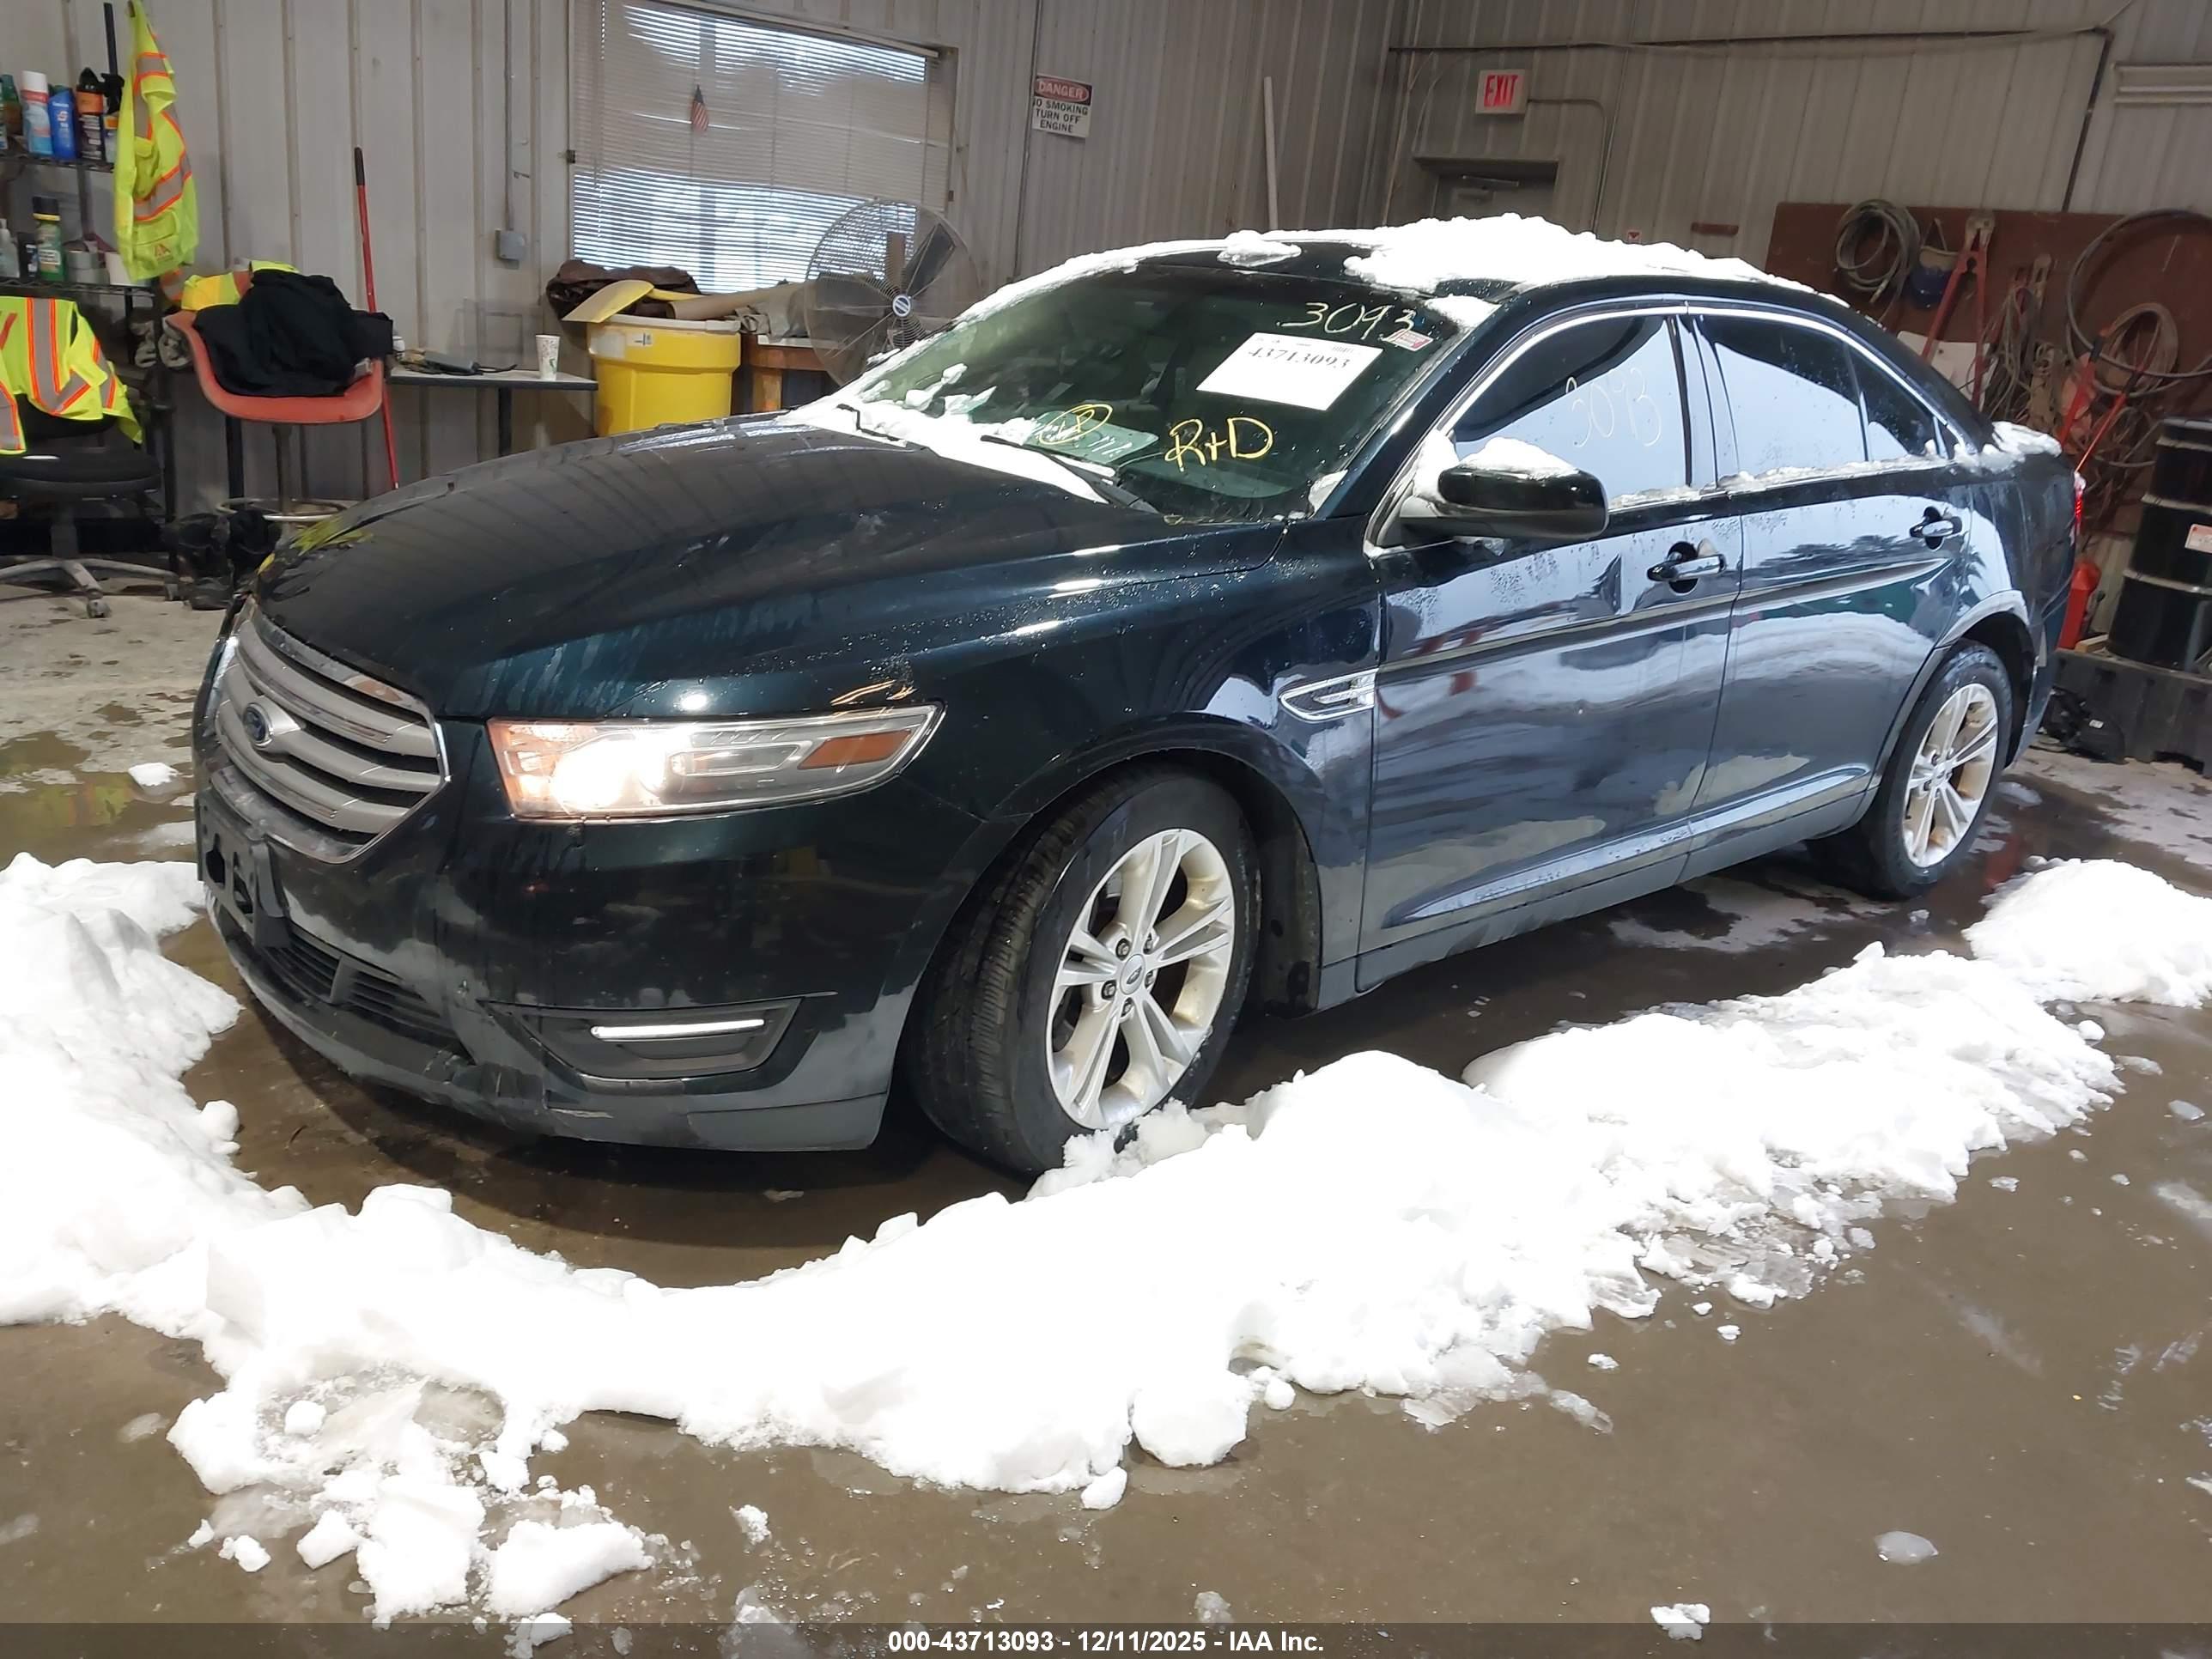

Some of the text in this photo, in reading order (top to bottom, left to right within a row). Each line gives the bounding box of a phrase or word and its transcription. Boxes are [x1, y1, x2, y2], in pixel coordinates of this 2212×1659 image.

[1038, 81, 1084, 99] DANGER
[1484, 75, 1519, 107] EXIT
[1036, 108, 1081, 125] TURN OFF
[1046, 100, 1089, 116] SMOKING
[1040, 119, 1074, 133] ENGINE
[1276, 301, 1417, 342] 3093
[1248, 346, 1351, 368] 43713093
